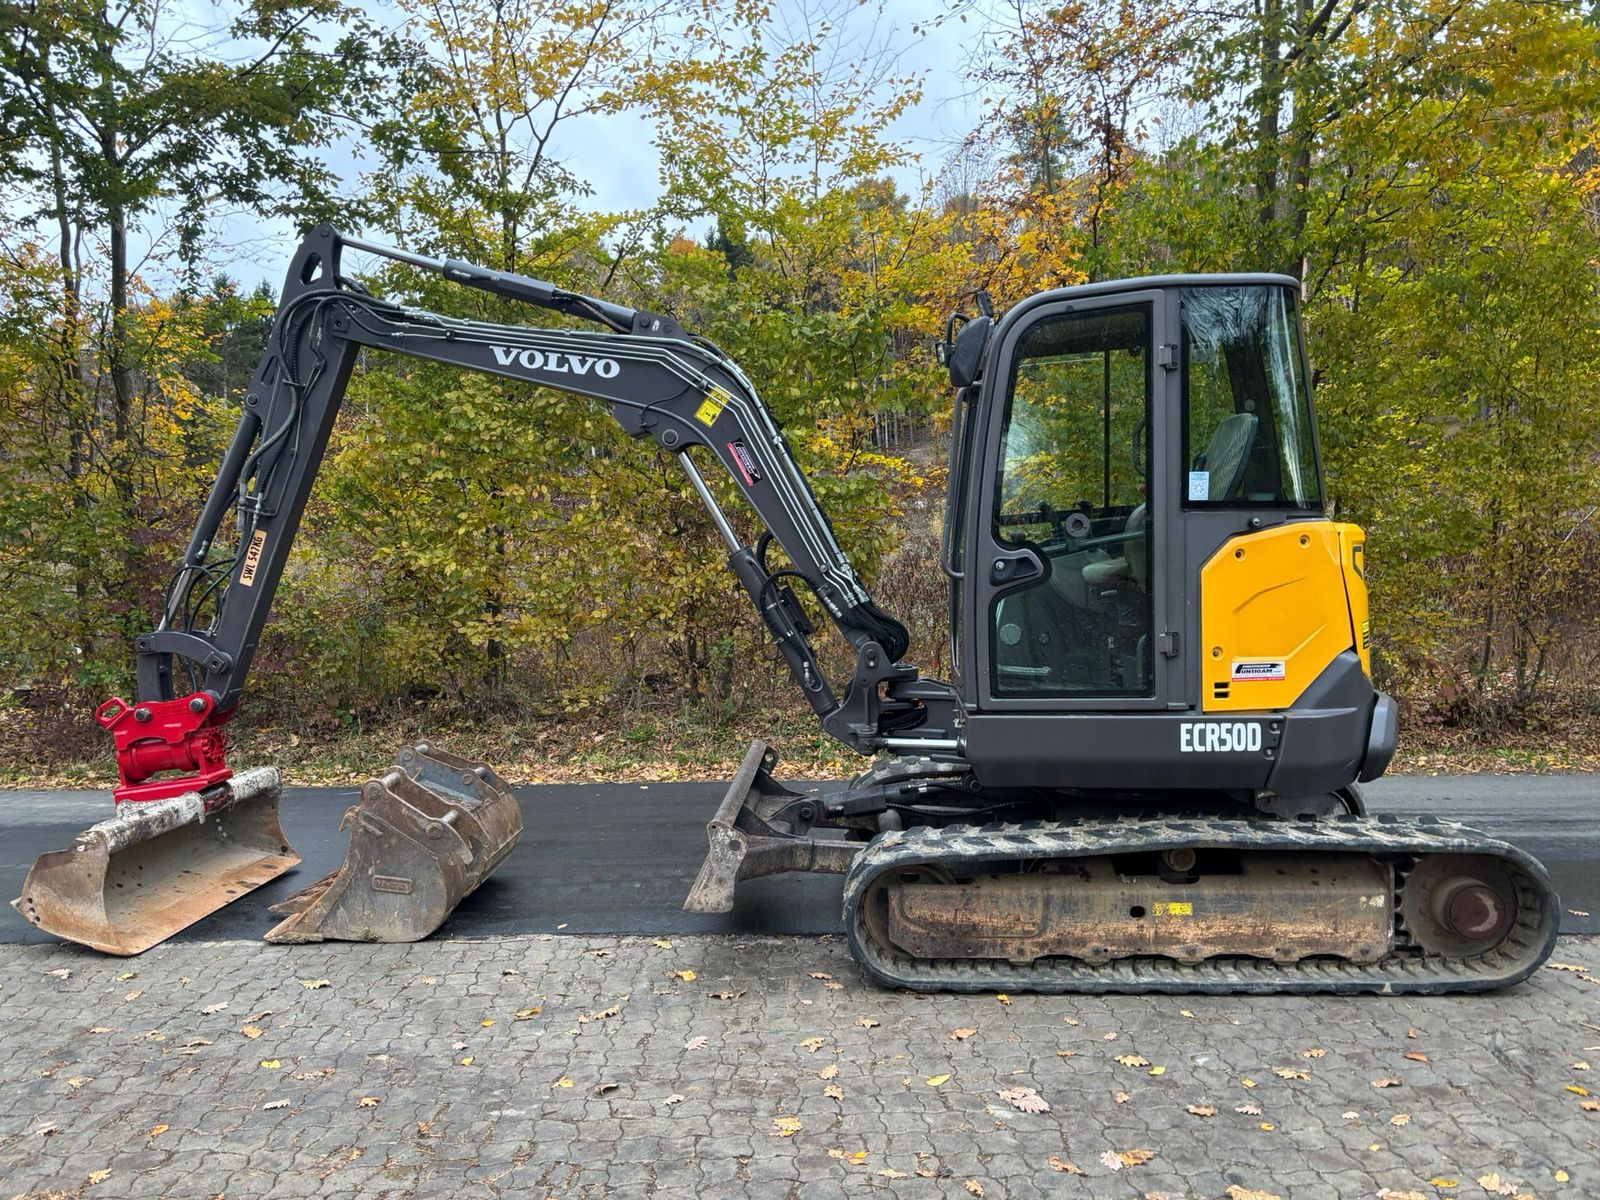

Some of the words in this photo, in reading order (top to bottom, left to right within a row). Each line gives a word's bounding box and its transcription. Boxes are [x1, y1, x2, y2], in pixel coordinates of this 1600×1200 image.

[489, 345, 620, 379] VOLVO
[248, 536, 263, 562] 547KG
[243, 564, 256, 580] SWL
[1180, 723, 1262, 752] ECR50D
